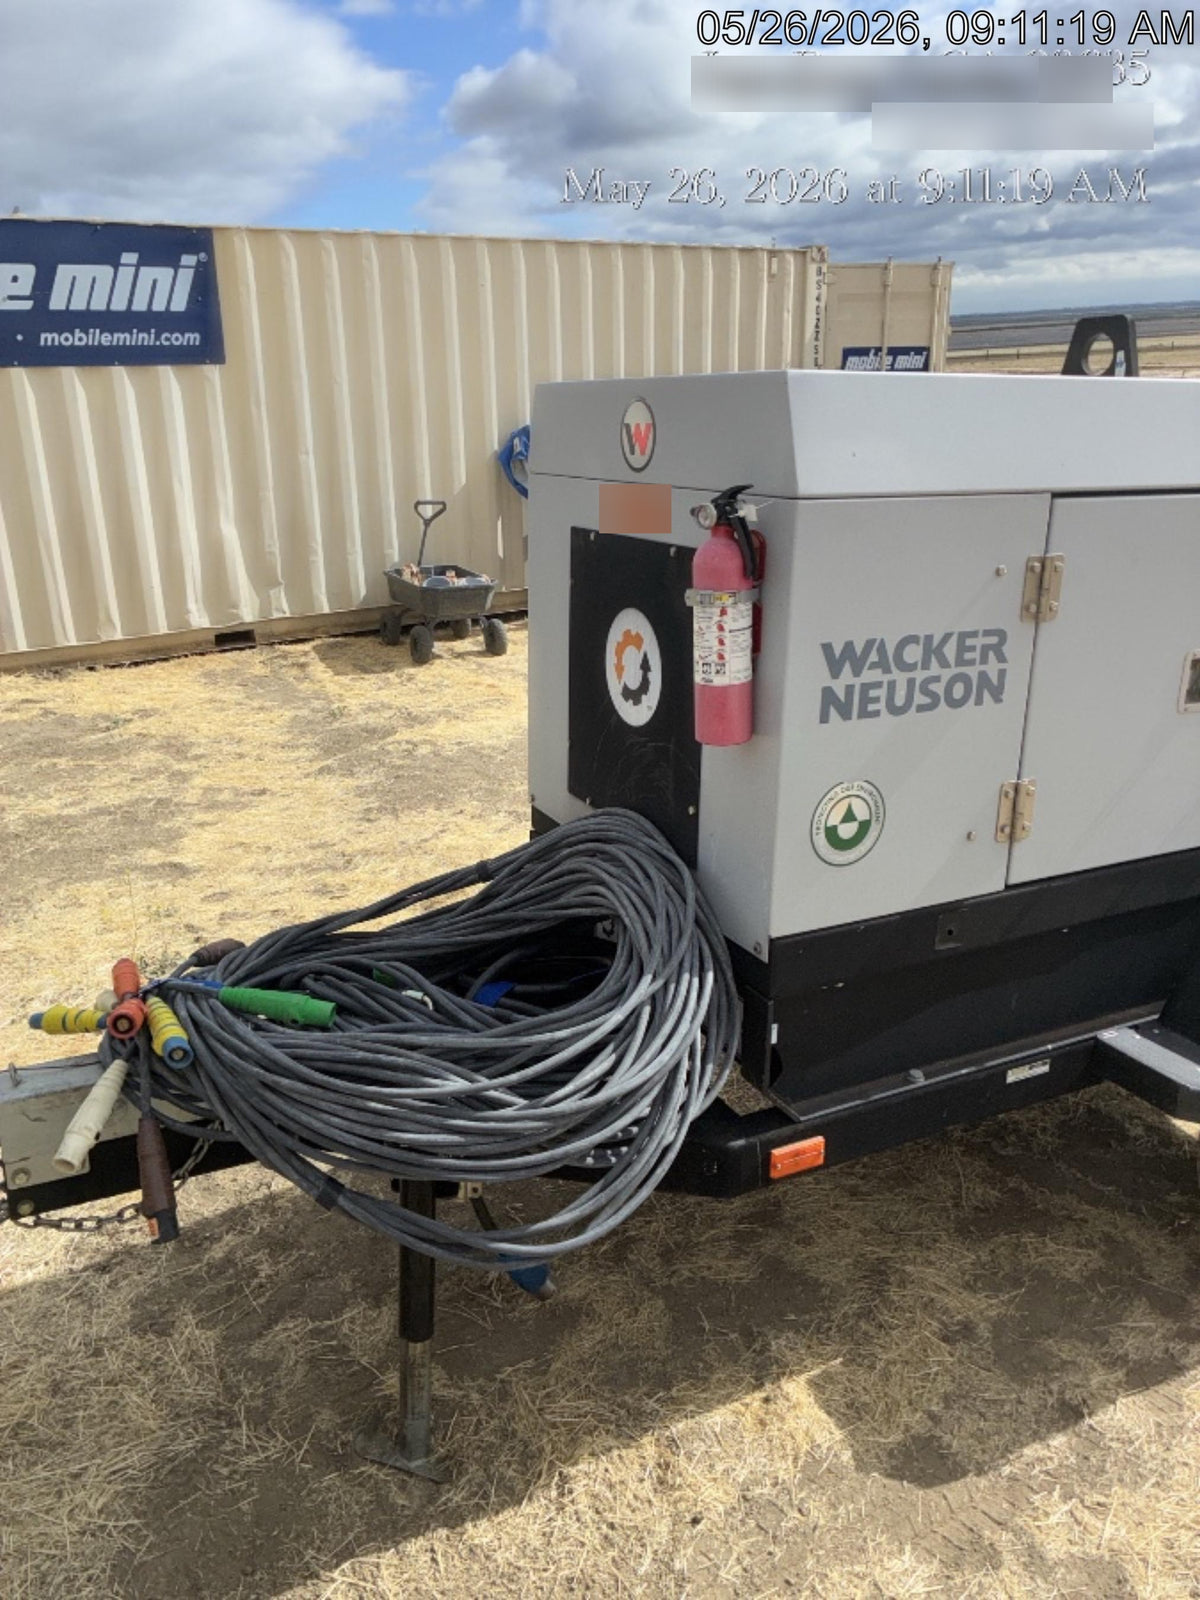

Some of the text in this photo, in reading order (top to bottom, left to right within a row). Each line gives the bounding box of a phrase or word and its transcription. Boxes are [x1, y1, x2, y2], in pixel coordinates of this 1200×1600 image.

[48, 252, 199, 312] mini
[39, 328, 201, 346] mobilemini.com
[846, 348, 928, 371] mobie mini
[623, 422, 652, 456] W
[819, 628, 1009, 680] WACKER
[818, 668, 1007, 725] NEUSON
